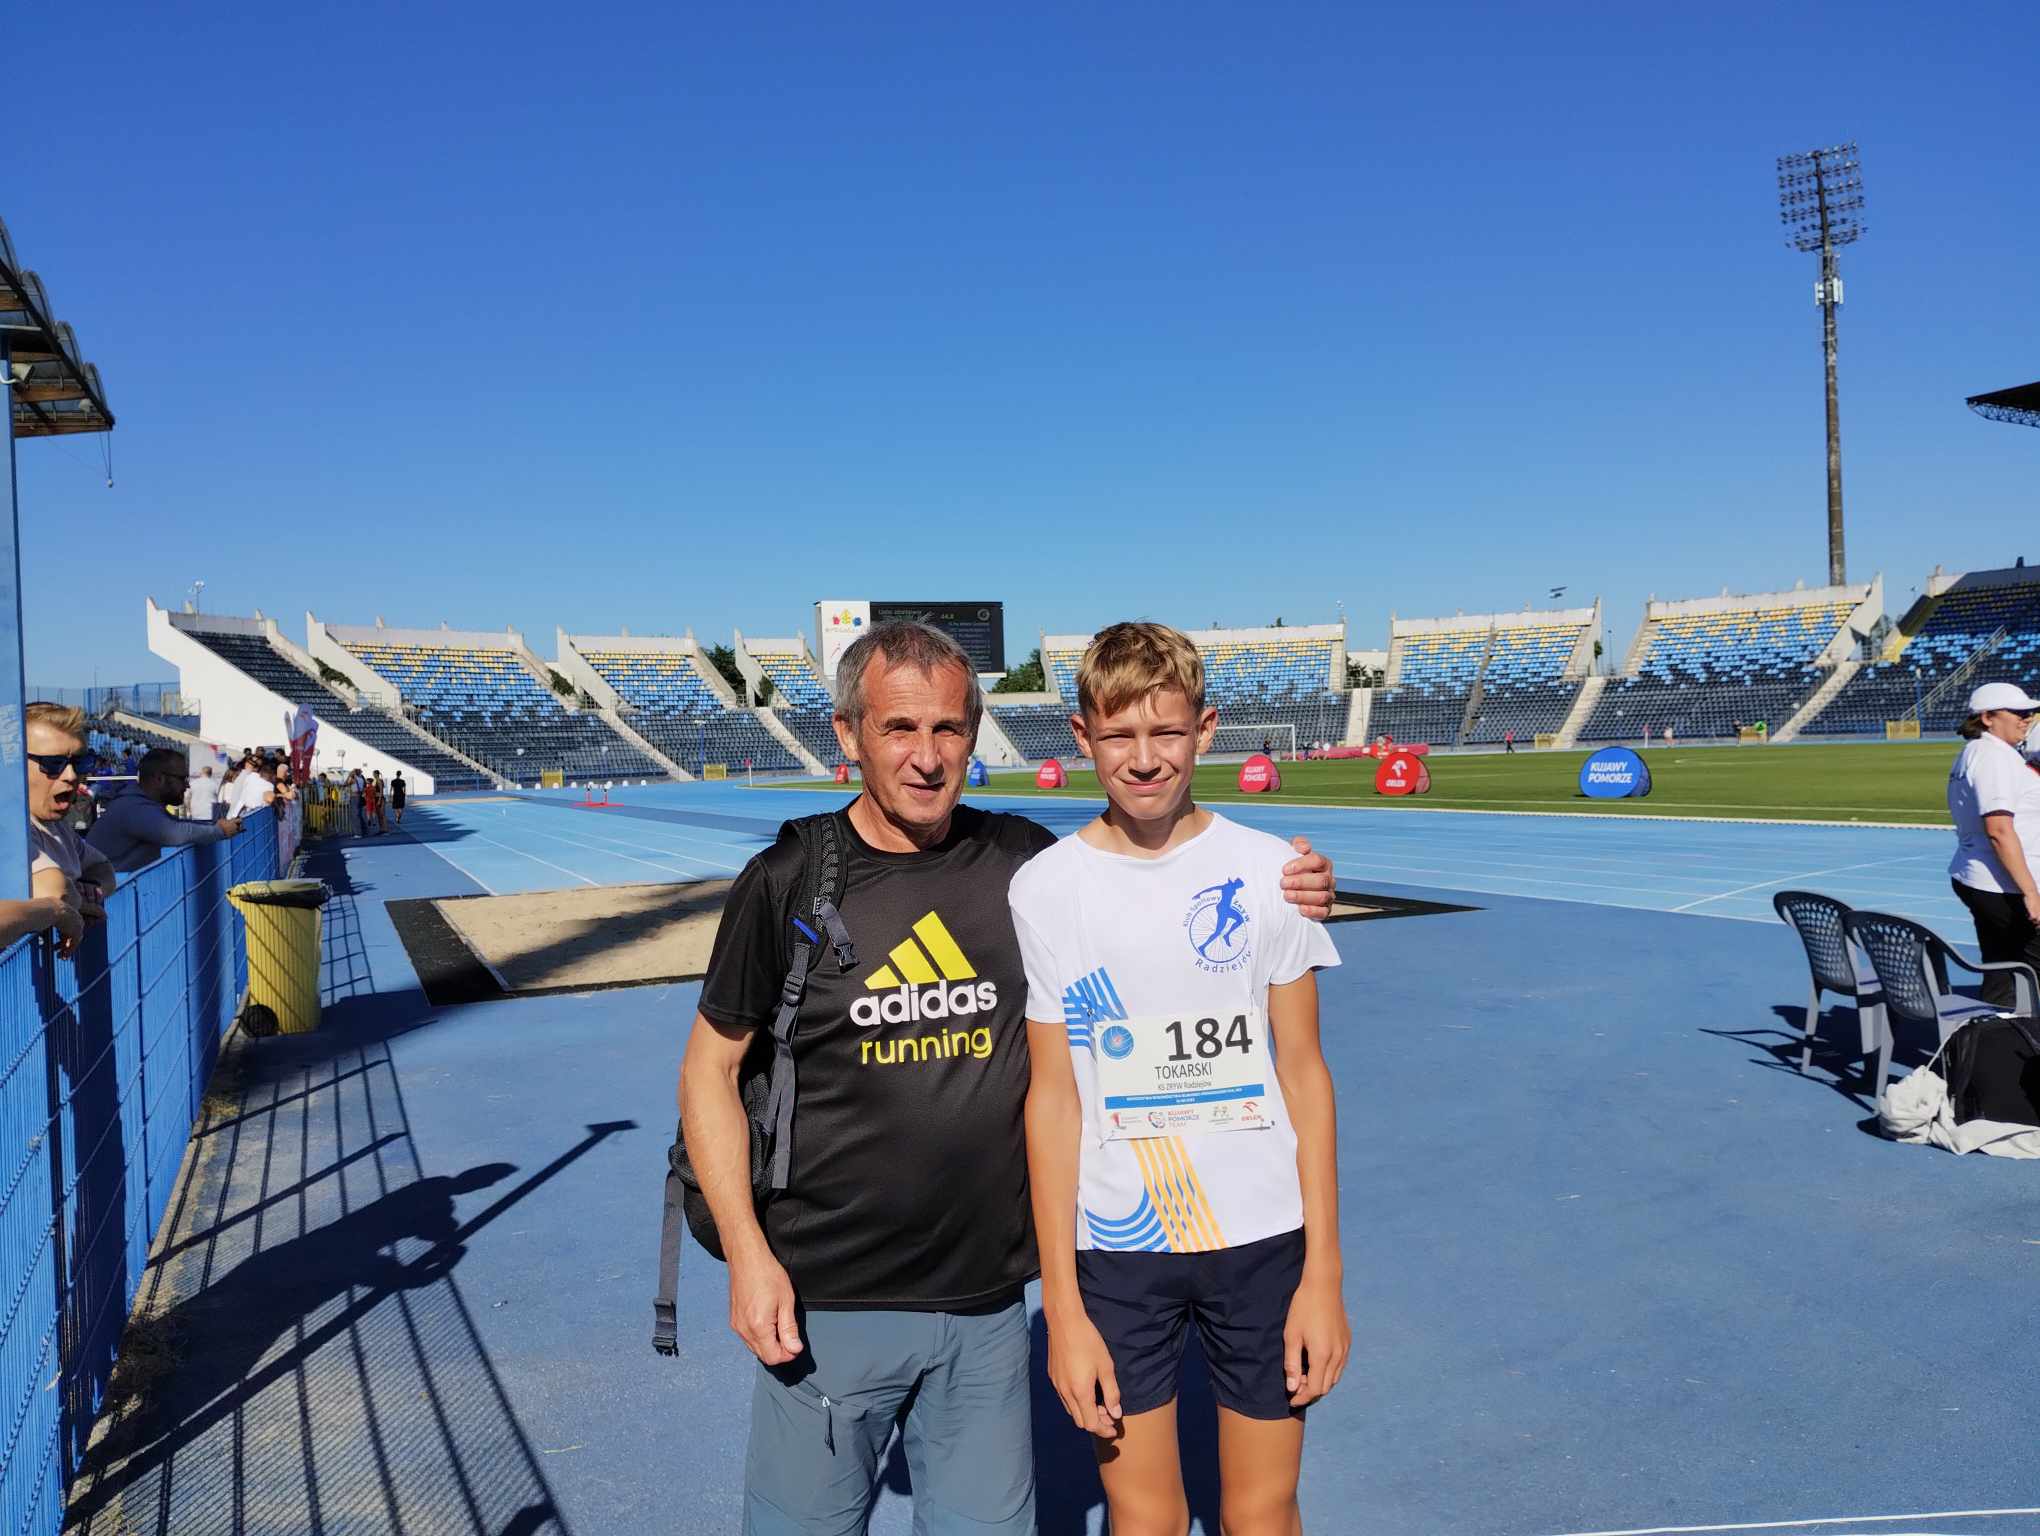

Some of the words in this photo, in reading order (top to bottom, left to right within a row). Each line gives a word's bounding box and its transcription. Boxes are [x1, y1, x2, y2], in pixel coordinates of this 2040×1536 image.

[1587, 772, 1632, 784] POMORZE
[1590, 761, 1628, 772] KUJAWY
[850, 979, 998, 1027] adidas
[861, 1027, 993, 1065] running
[1166, 1014, 1253, 1061] 184
[1154, 1061, 1213, 1081] TOKARSKI
